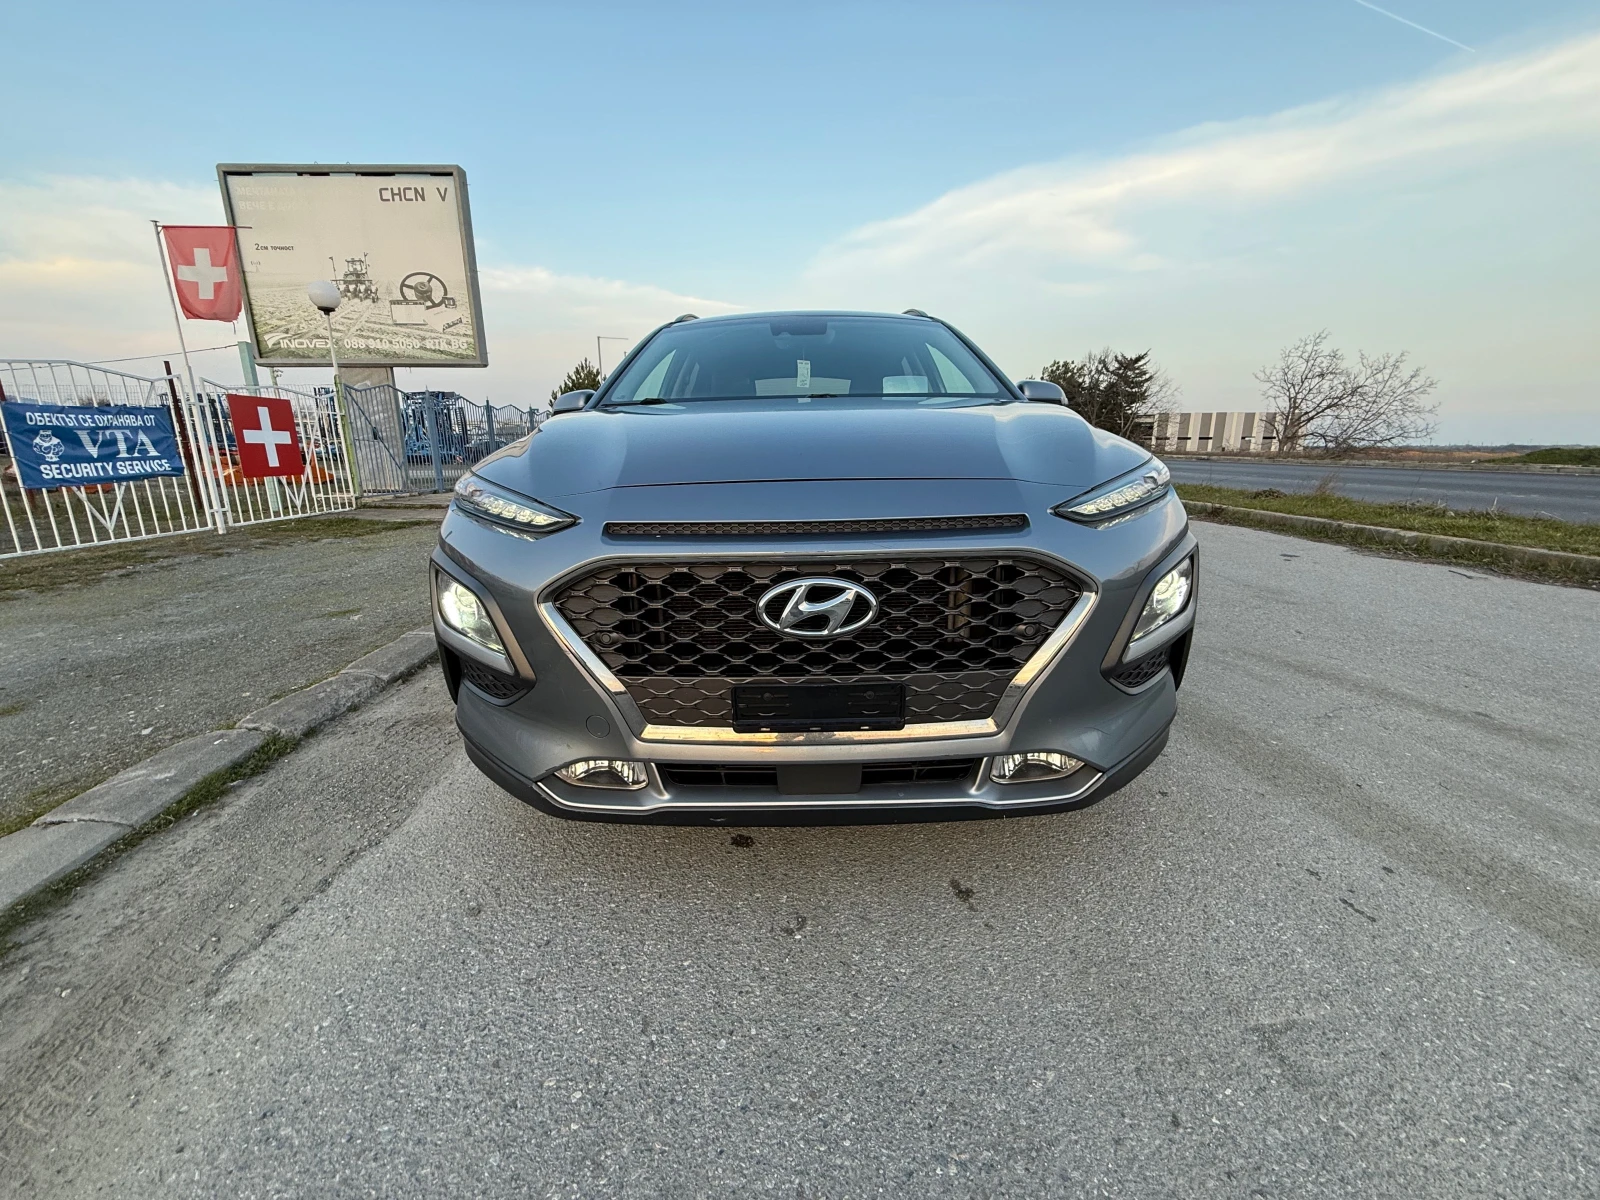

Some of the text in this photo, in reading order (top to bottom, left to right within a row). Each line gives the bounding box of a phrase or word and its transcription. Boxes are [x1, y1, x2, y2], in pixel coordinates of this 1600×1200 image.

[344, 339, 366, 349] 088
[392, 339, 420, 349] 5050
[26, 411, 156, 427] ОБЕКТЪТ СЕ ОХРАНЯВА ОТ
[73, 429, 161, 459] VTA
[40, 459, 173, 480] SECURITY SERVICE
